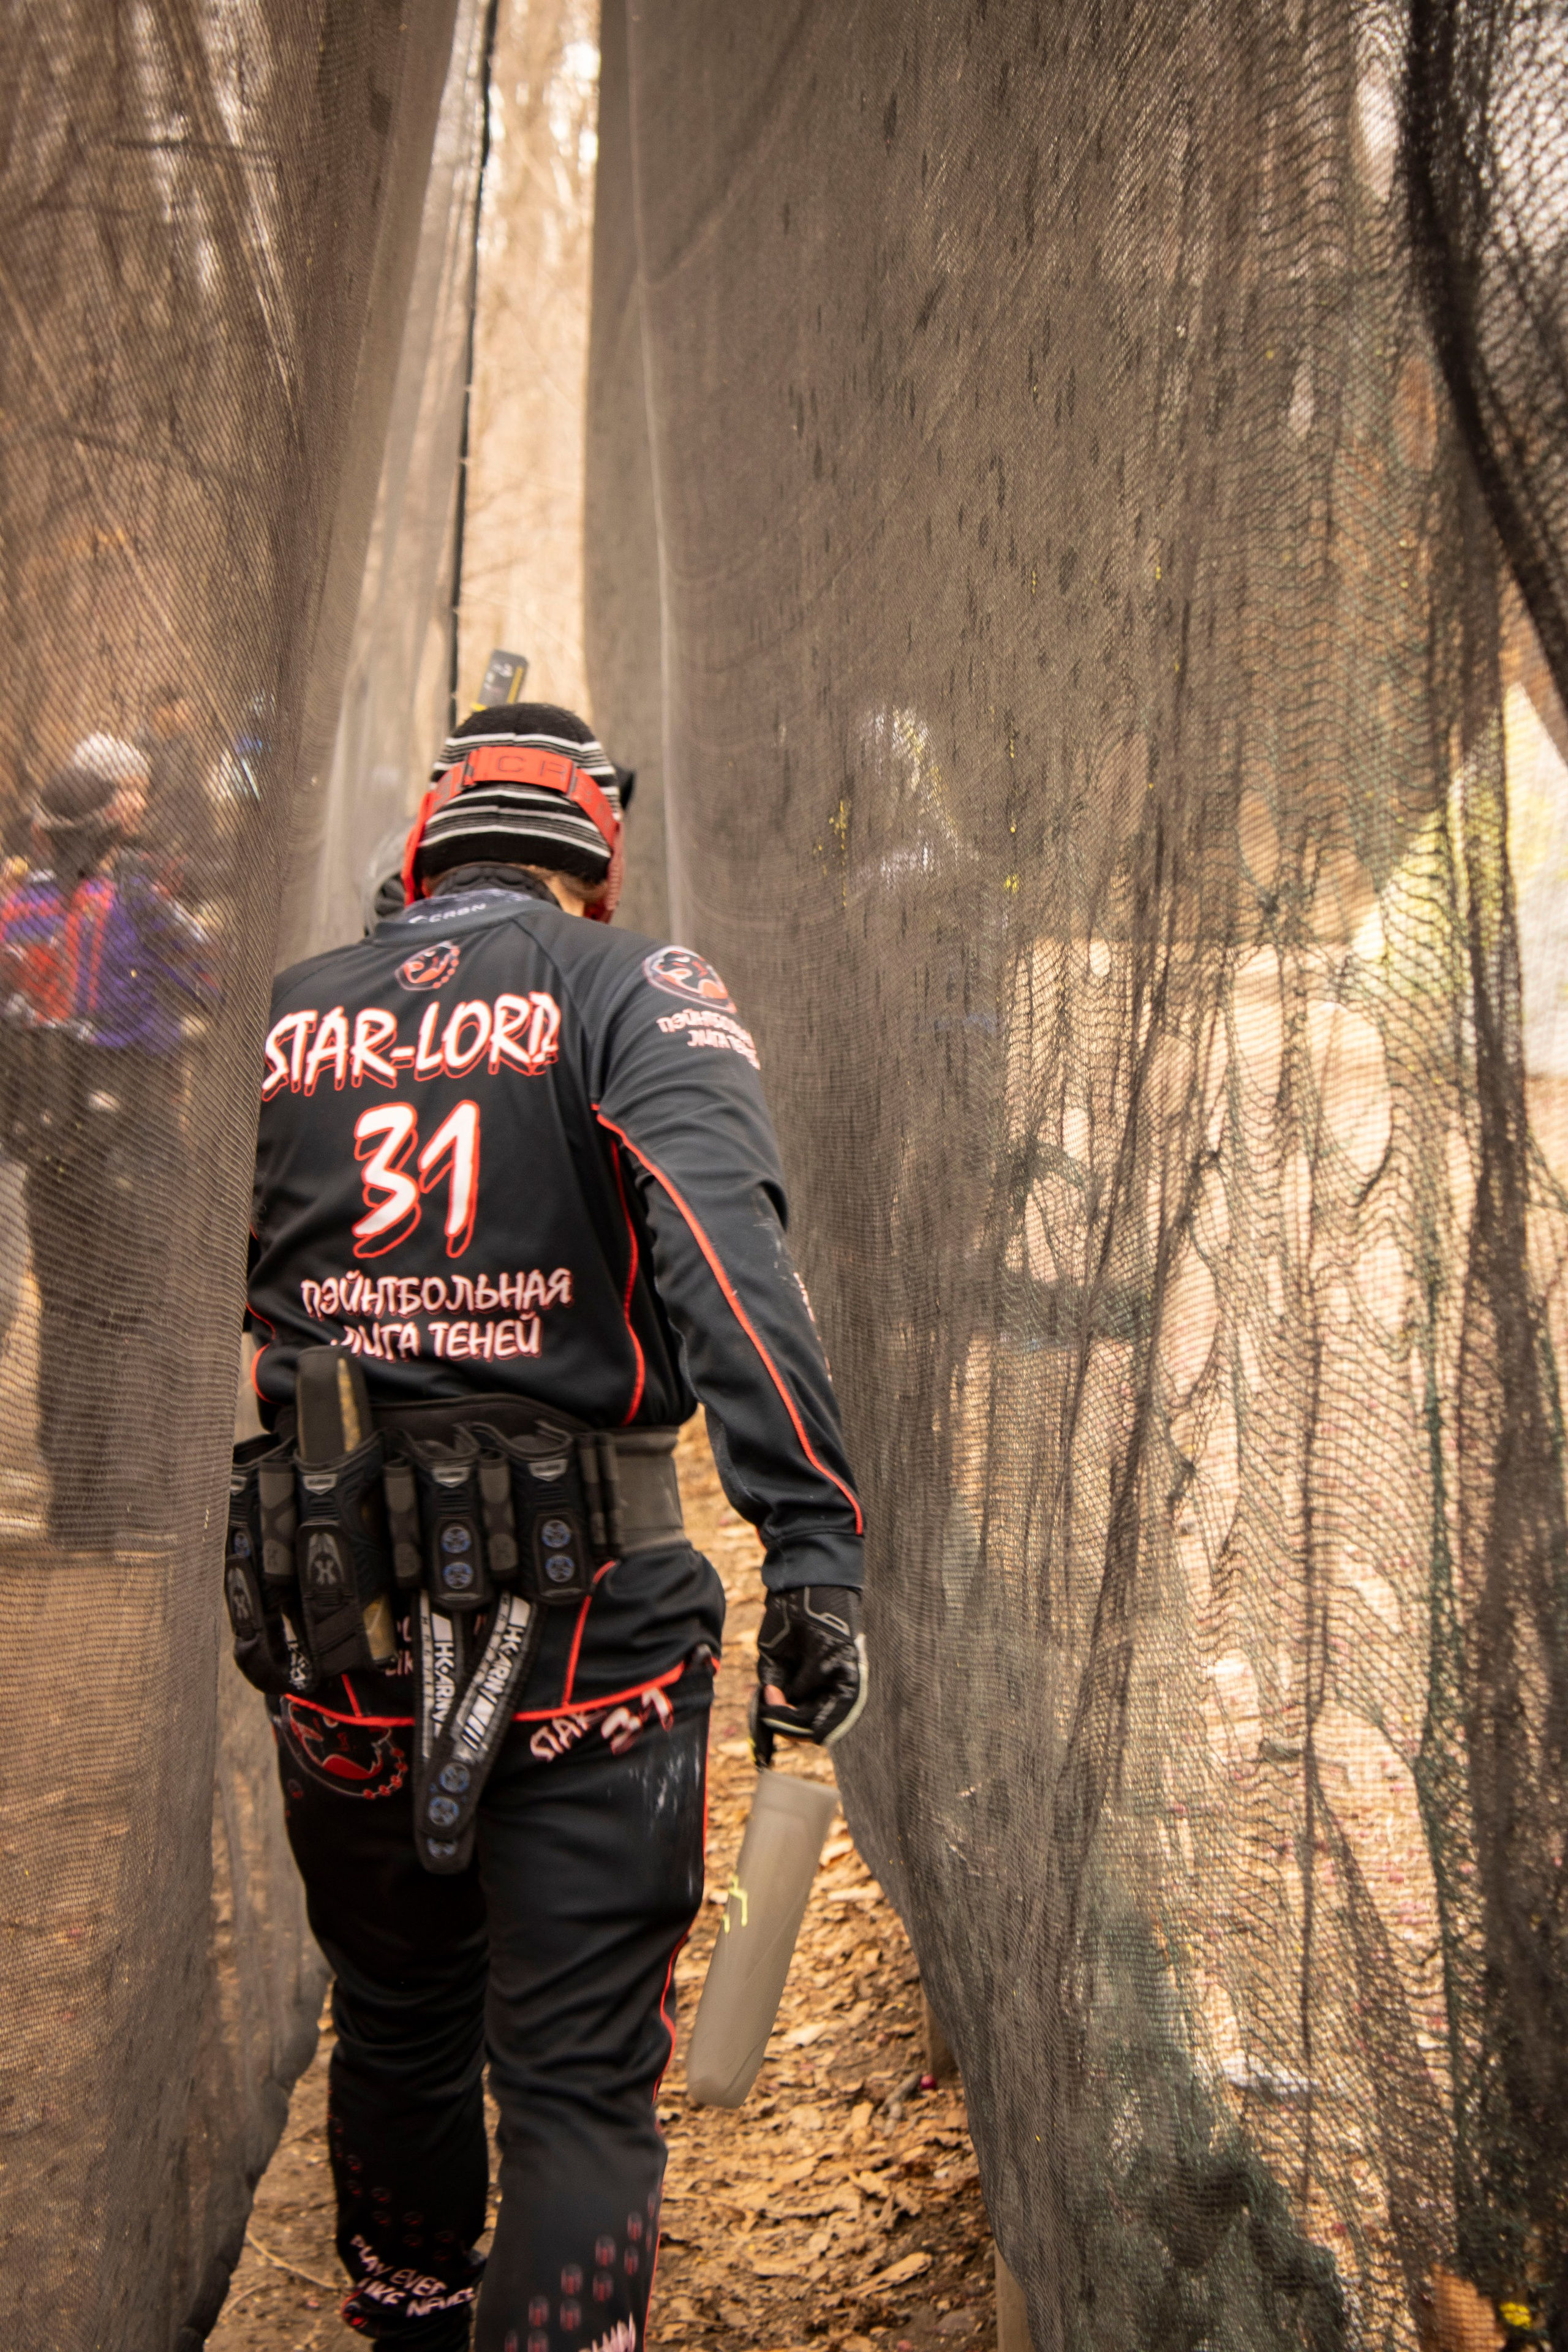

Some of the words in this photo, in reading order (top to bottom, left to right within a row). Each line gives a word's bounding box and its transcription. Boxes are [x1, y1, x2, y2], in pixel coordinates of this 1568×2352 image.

[262, 992, 561, 1101] STAR-LORD
[353, 1100, 480, 1258] 31
[301, 1268, 573, 1318] ПЭЙНТБОЛЬНАЯ
[428, 1315, 543, 1361] ТЕНЕЙ
